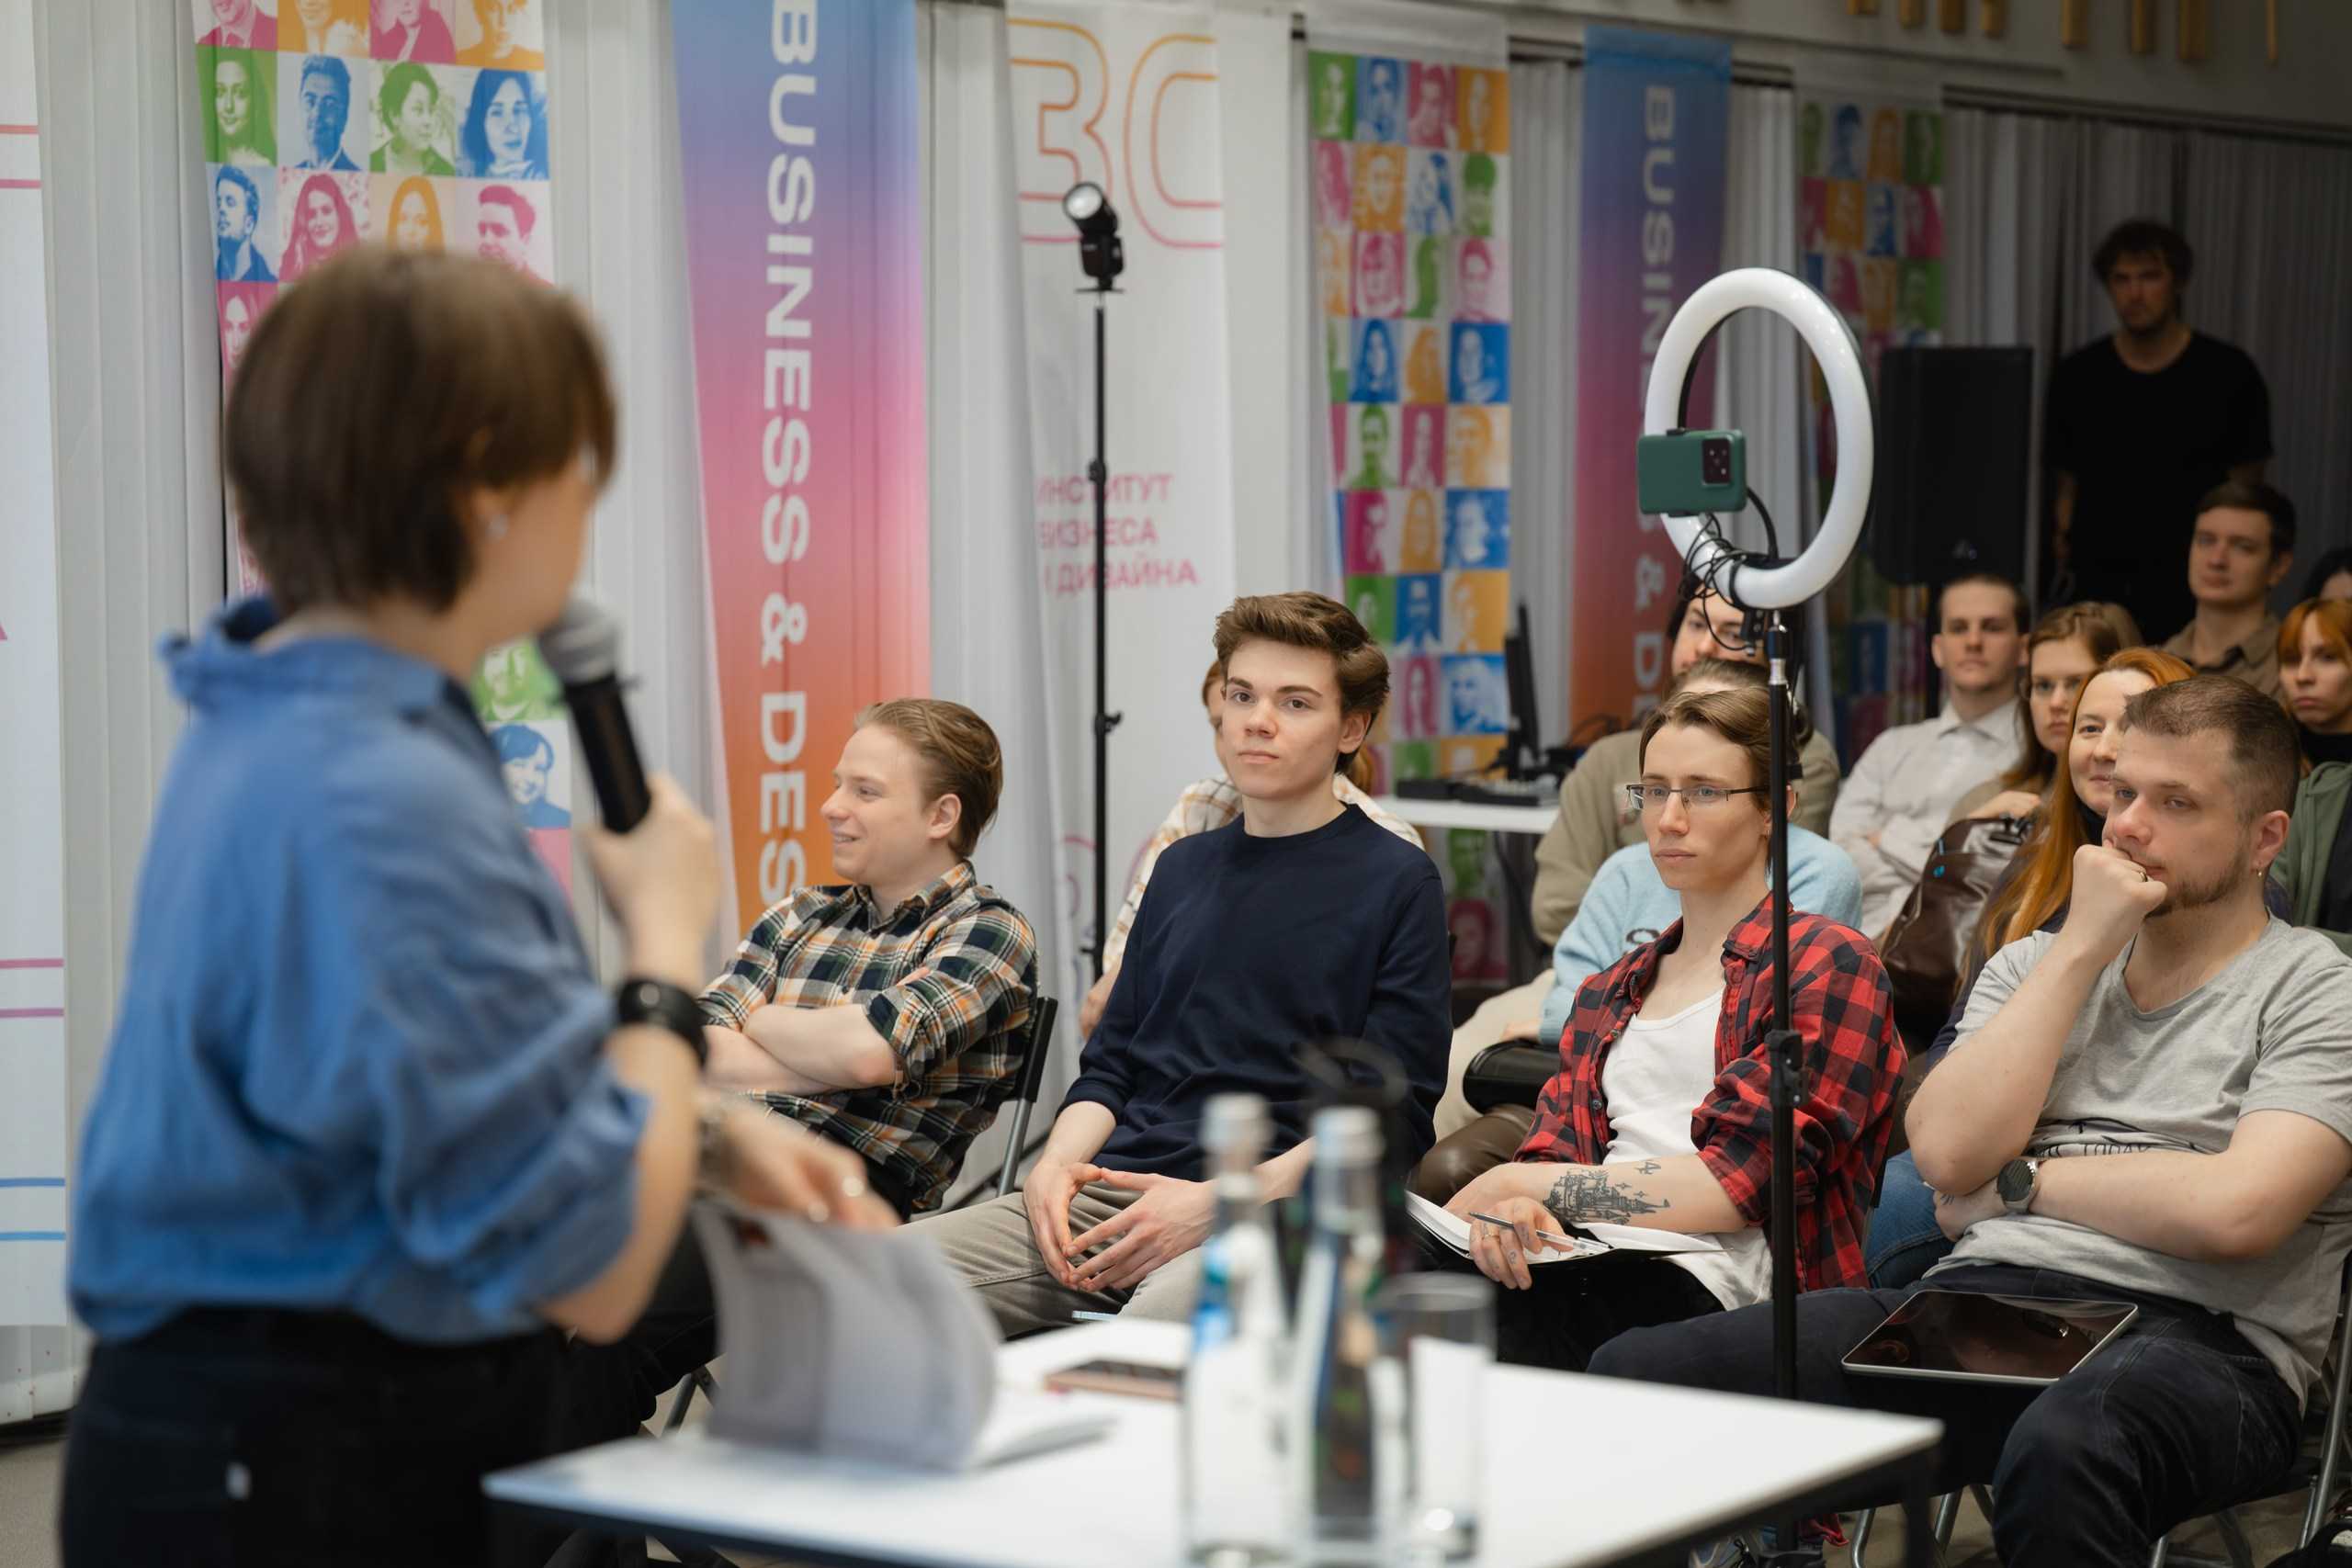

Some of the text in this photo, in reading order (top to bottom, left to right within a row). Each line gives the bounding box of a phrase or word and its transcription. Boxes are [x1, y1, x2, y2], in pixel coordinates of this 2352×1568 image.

[762, 0, 818, 564] BUSINESS
[1640, 85, 1676, 531] BUSIN
[761, 592, 808, 670] &
[1634, 554, 1666, 612] &
